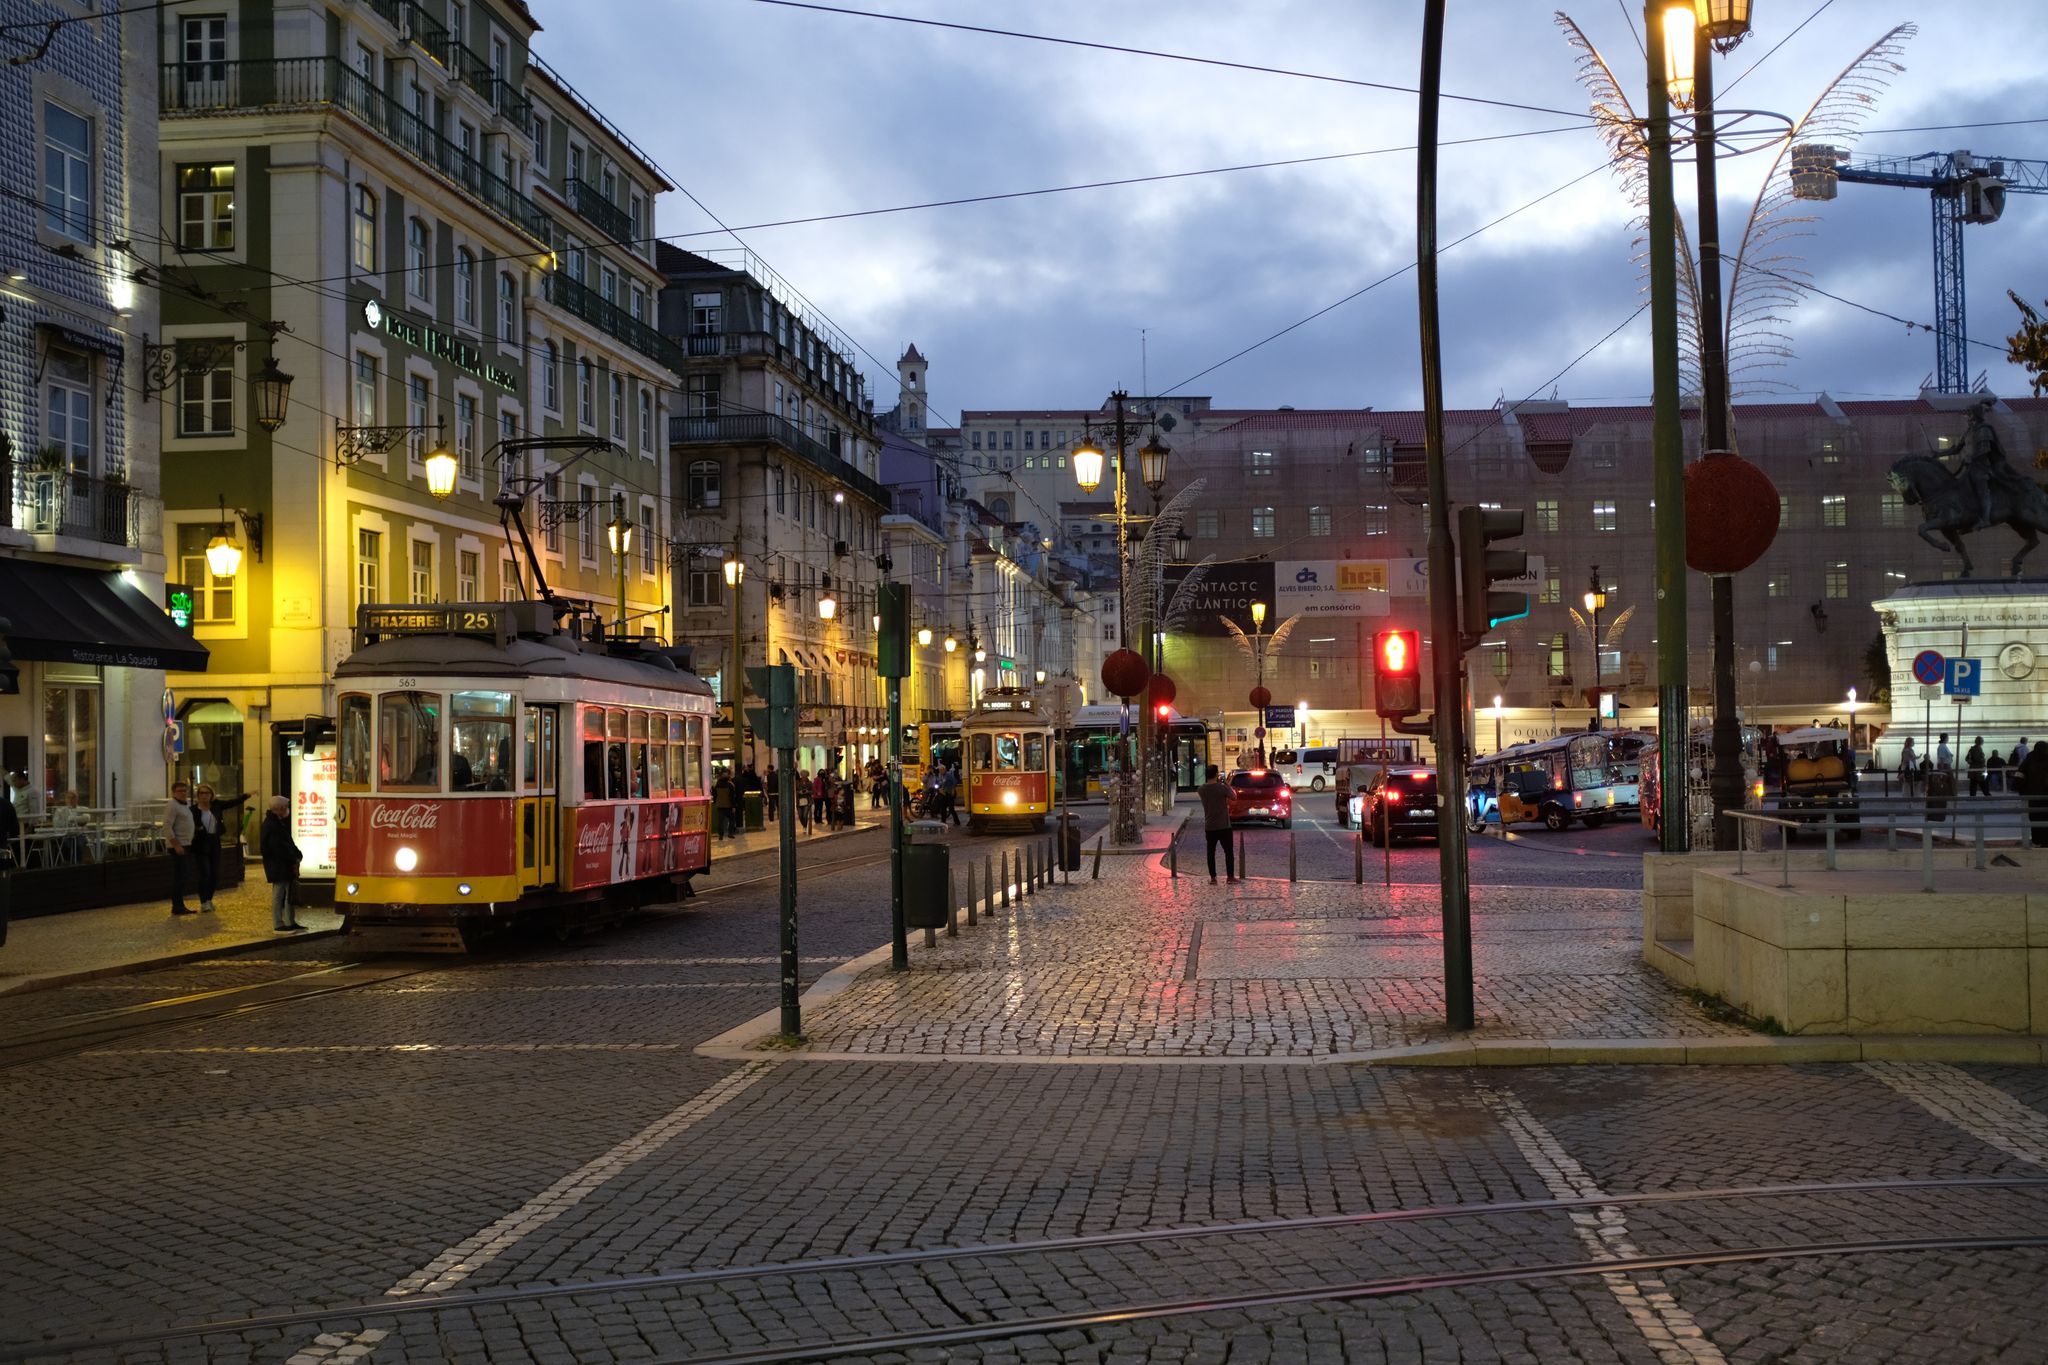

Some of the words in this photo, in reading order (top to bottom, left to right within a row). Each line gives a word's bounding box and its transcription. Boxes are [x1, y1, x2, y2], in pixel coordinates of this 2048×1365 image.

[1341, 566, 1381, 584] hci
[1320, 604, 1361, 612] consórcio
[370, 615, 443, 628] PRAZERES
[463, 612, 489, 629] 25
[1931, 615, 1969, 623] PORTUGAL
[72, 648, 112, 662] Ristorante
[116, 652, 127, 663] La
[129, 653, 158, 666] Squadra
[1953, 661, 1971, 686] P
[398, 679, 416, 687] 563
[1021, 701, 1030, 709] 12
[370, 804, 441, 828] Coca-Cola
[579, 822, 610, 855] Coca-Cola
